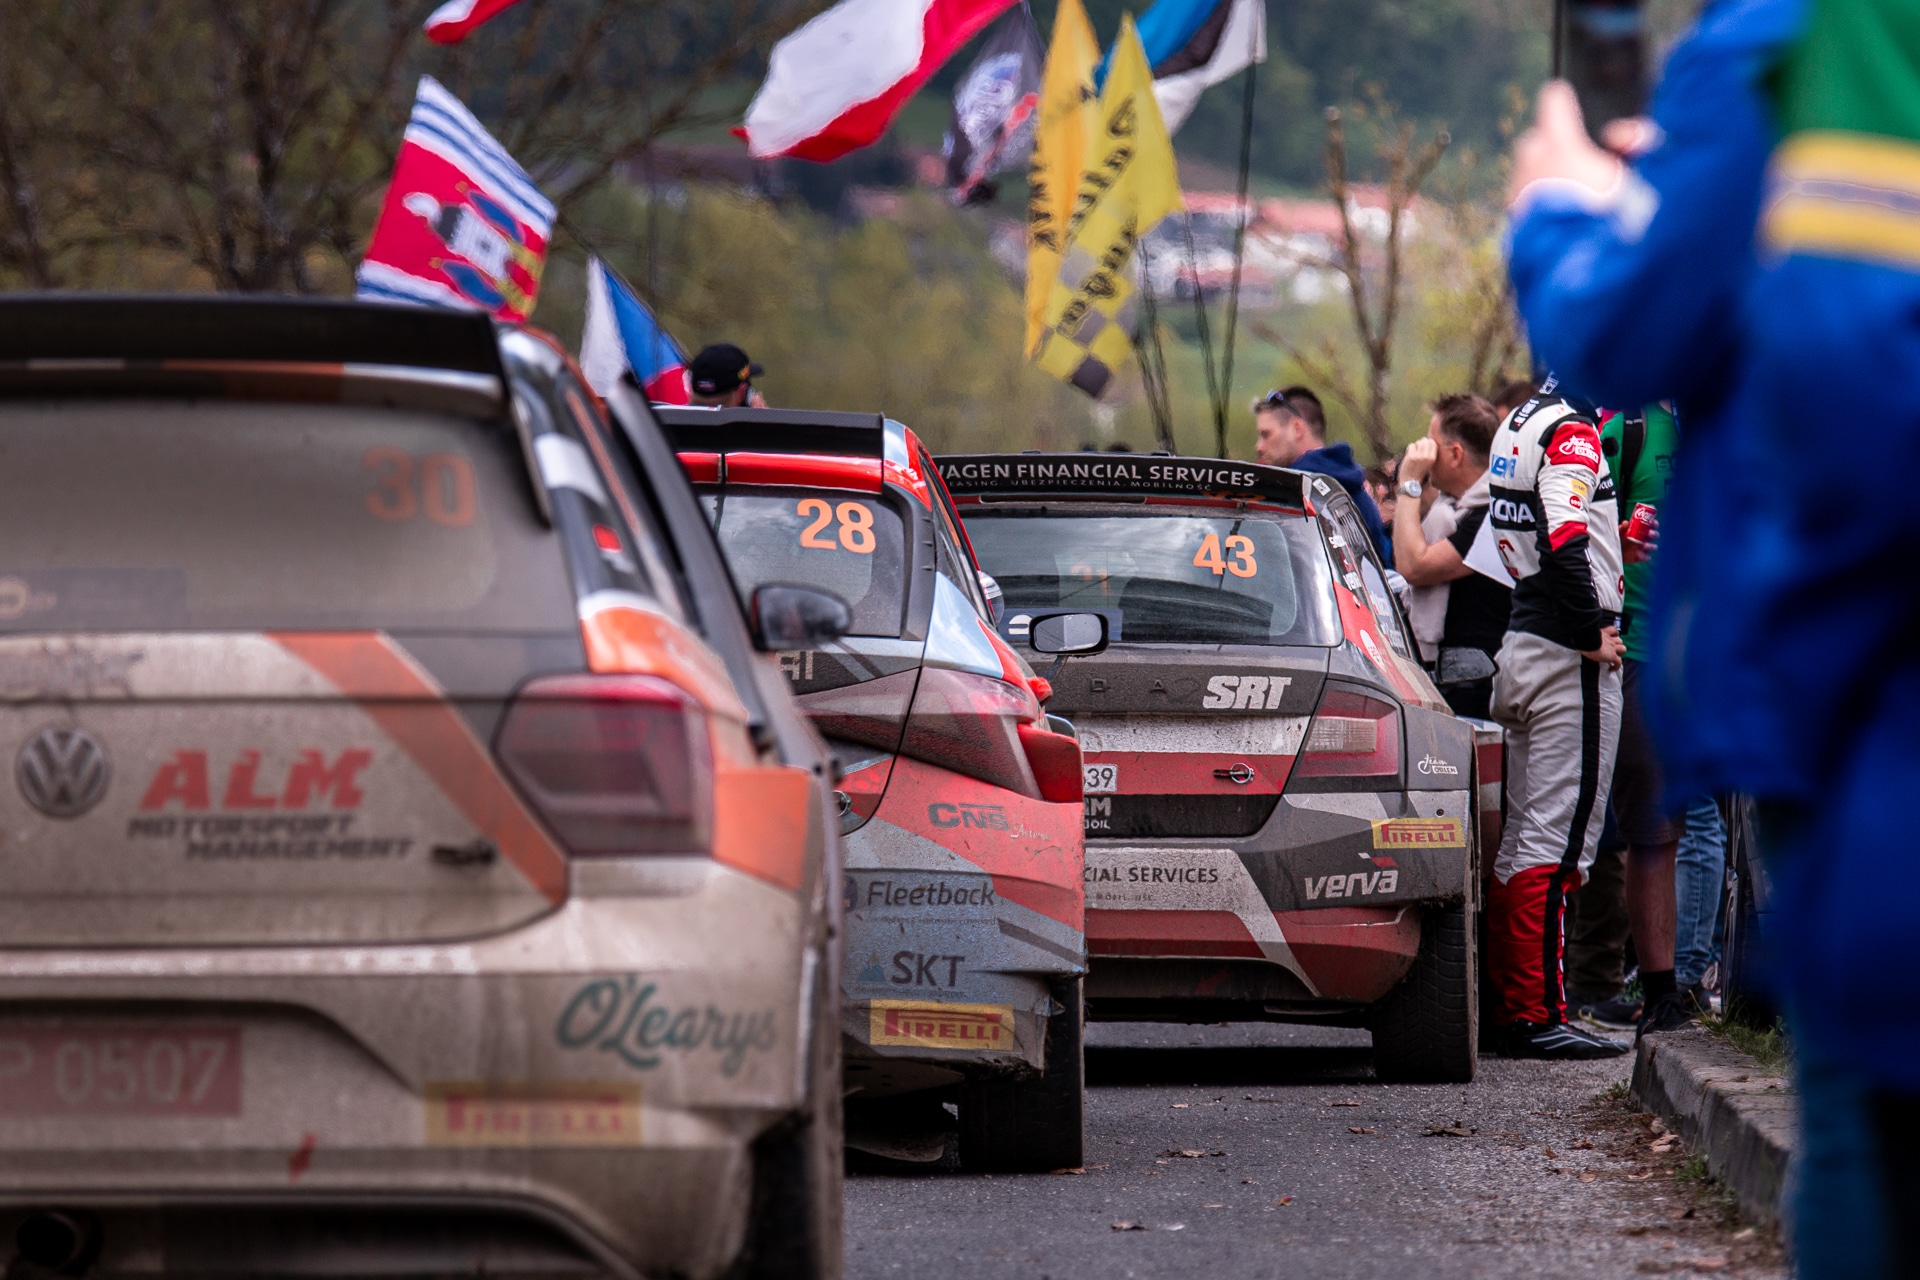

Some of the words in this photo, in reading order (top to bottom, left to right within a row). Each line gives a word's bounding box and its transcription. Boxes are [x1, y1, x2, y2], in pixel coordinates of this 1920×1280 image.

[362, 445, 477, 527] 30
[949, 479, 998, 487] EASING
[1017, 463, 1142, 480] FINANCIAL
[1150, 465, 1255, 487] SERVICES
[797, 498, 876, 555] 28
[1193, 533, 1258, 578] 43
[1202, 675, 1293, 710] SRT
[138, 747, 375, 811] ALM
[1083, 767, 1113, 788] 39
[127, 814, 356, 840] MOTORSPORT
[927, 802, 1011, 832] CNS
[1381, 823, 1457, 843] PIRELLI
[185, 837, 414, 861] MANAGEMENT
[1128, 866, 1219, 883] SERVICES
[1305, 869, 1399, 901] verva
[867, 880, 996, 907] Fleetback
[890, 951, 966, 988] SKT
[555, 972, 777, 1078] O'Learys
[884, 1008, 1001, 1041] PIRELLI
[54, 1038, 227, 1101] 0507
